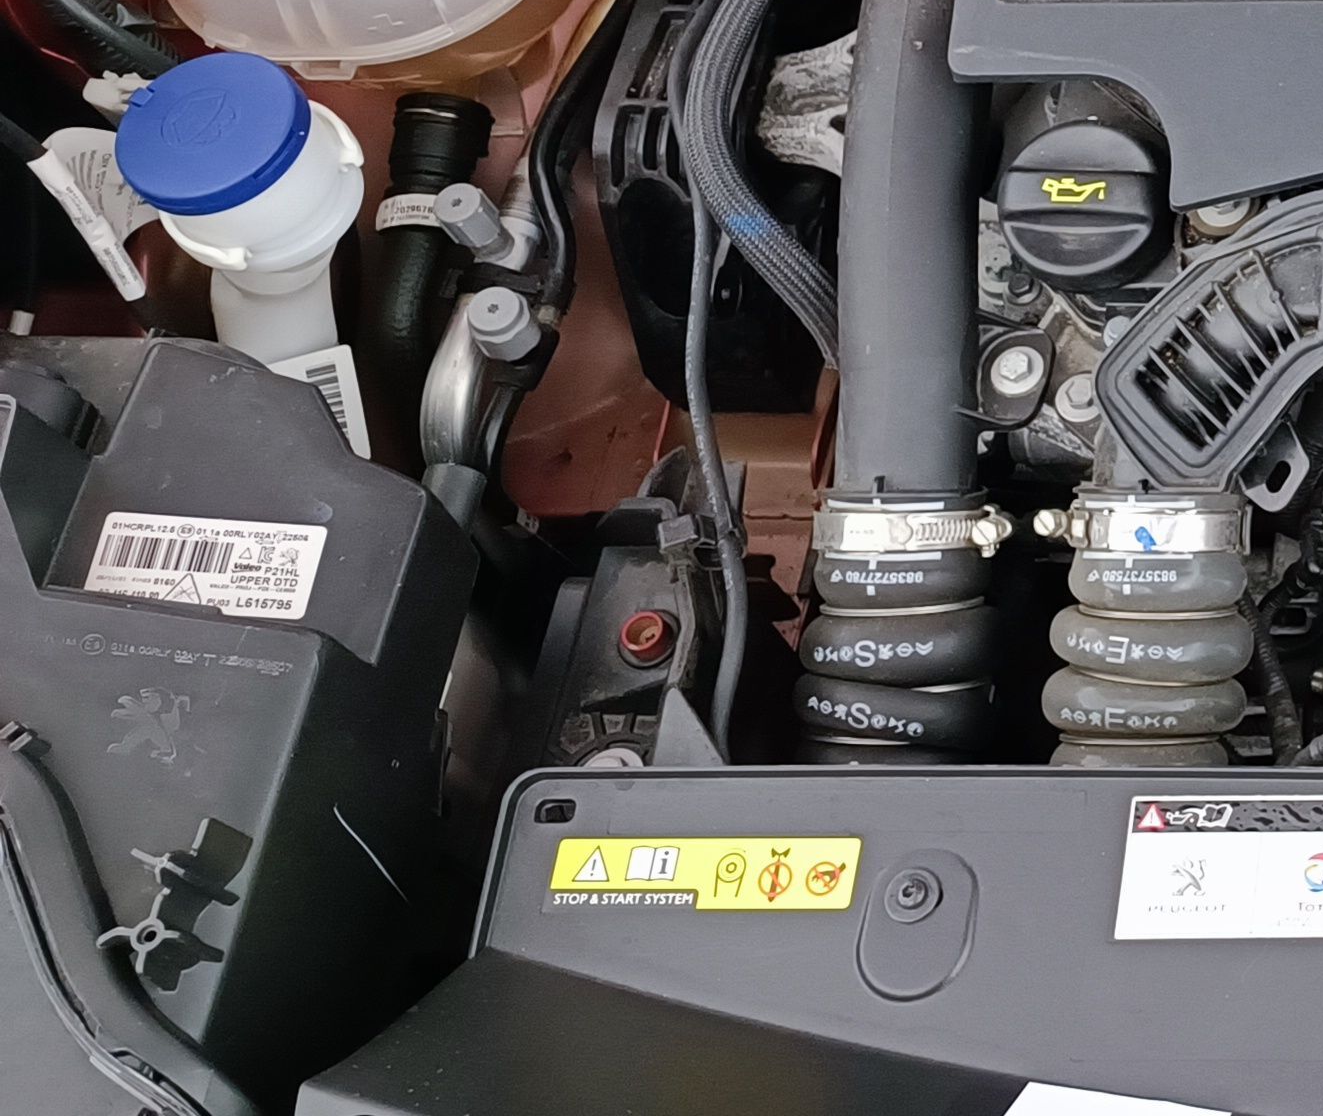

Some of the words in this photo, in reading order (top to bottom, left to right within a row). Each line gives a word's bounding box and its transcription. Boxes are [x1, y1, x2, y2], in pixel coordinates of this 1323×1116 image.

[264, 566, 300, 578] P21HL
[845, 571, 924, 583] 9835727780
[230, 576, 270, 586] UPPER
[274, 577, 299, 588] DTD
[236, 599, 292, 611] L615795
[553, 893, 588, 905] STOP
[589, 894, 600, 905] &
[601, 893, 641, 905] START
[644, 893, 694, 905] SYSTEM
